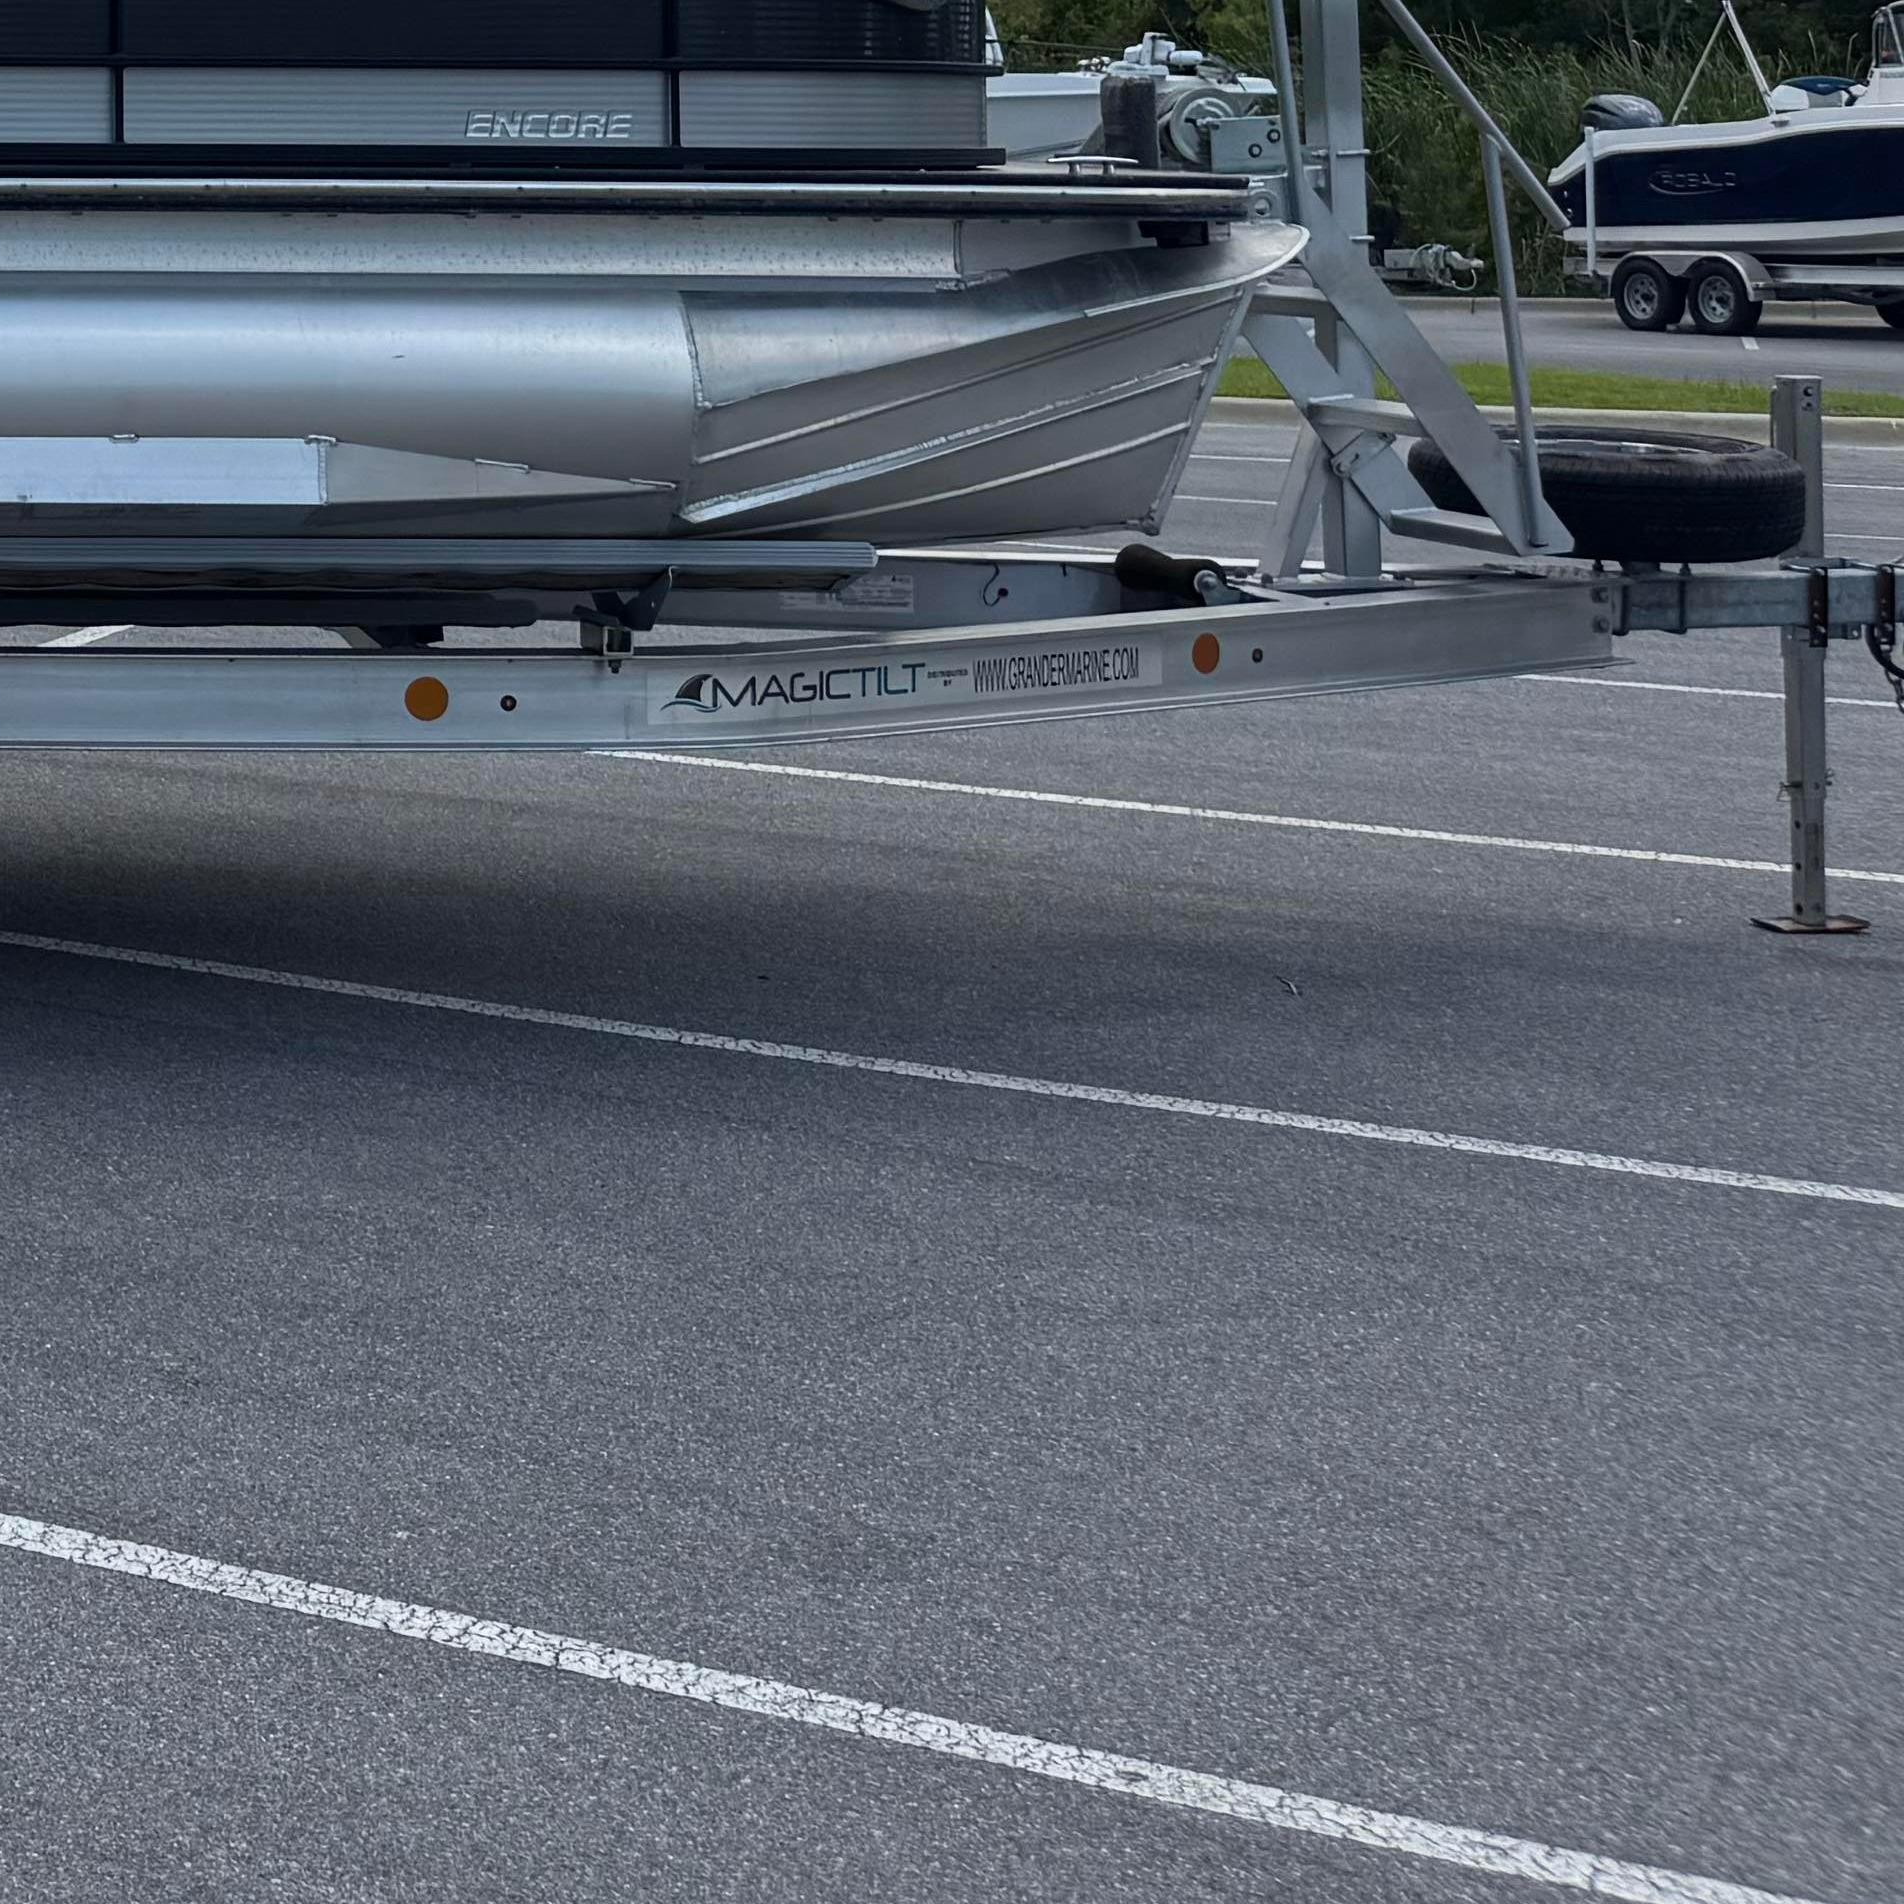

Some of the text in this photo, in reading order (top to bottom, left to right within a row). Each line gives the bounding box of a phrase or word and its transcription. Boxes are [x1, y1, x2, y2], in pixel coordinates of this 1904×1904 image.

[465, 110, 634, 138] ENCORE
[712, 662, 926, 708] MAGICTILT
[972, 646, 1139, 693] WWW.GRANDERMARINE.COM
